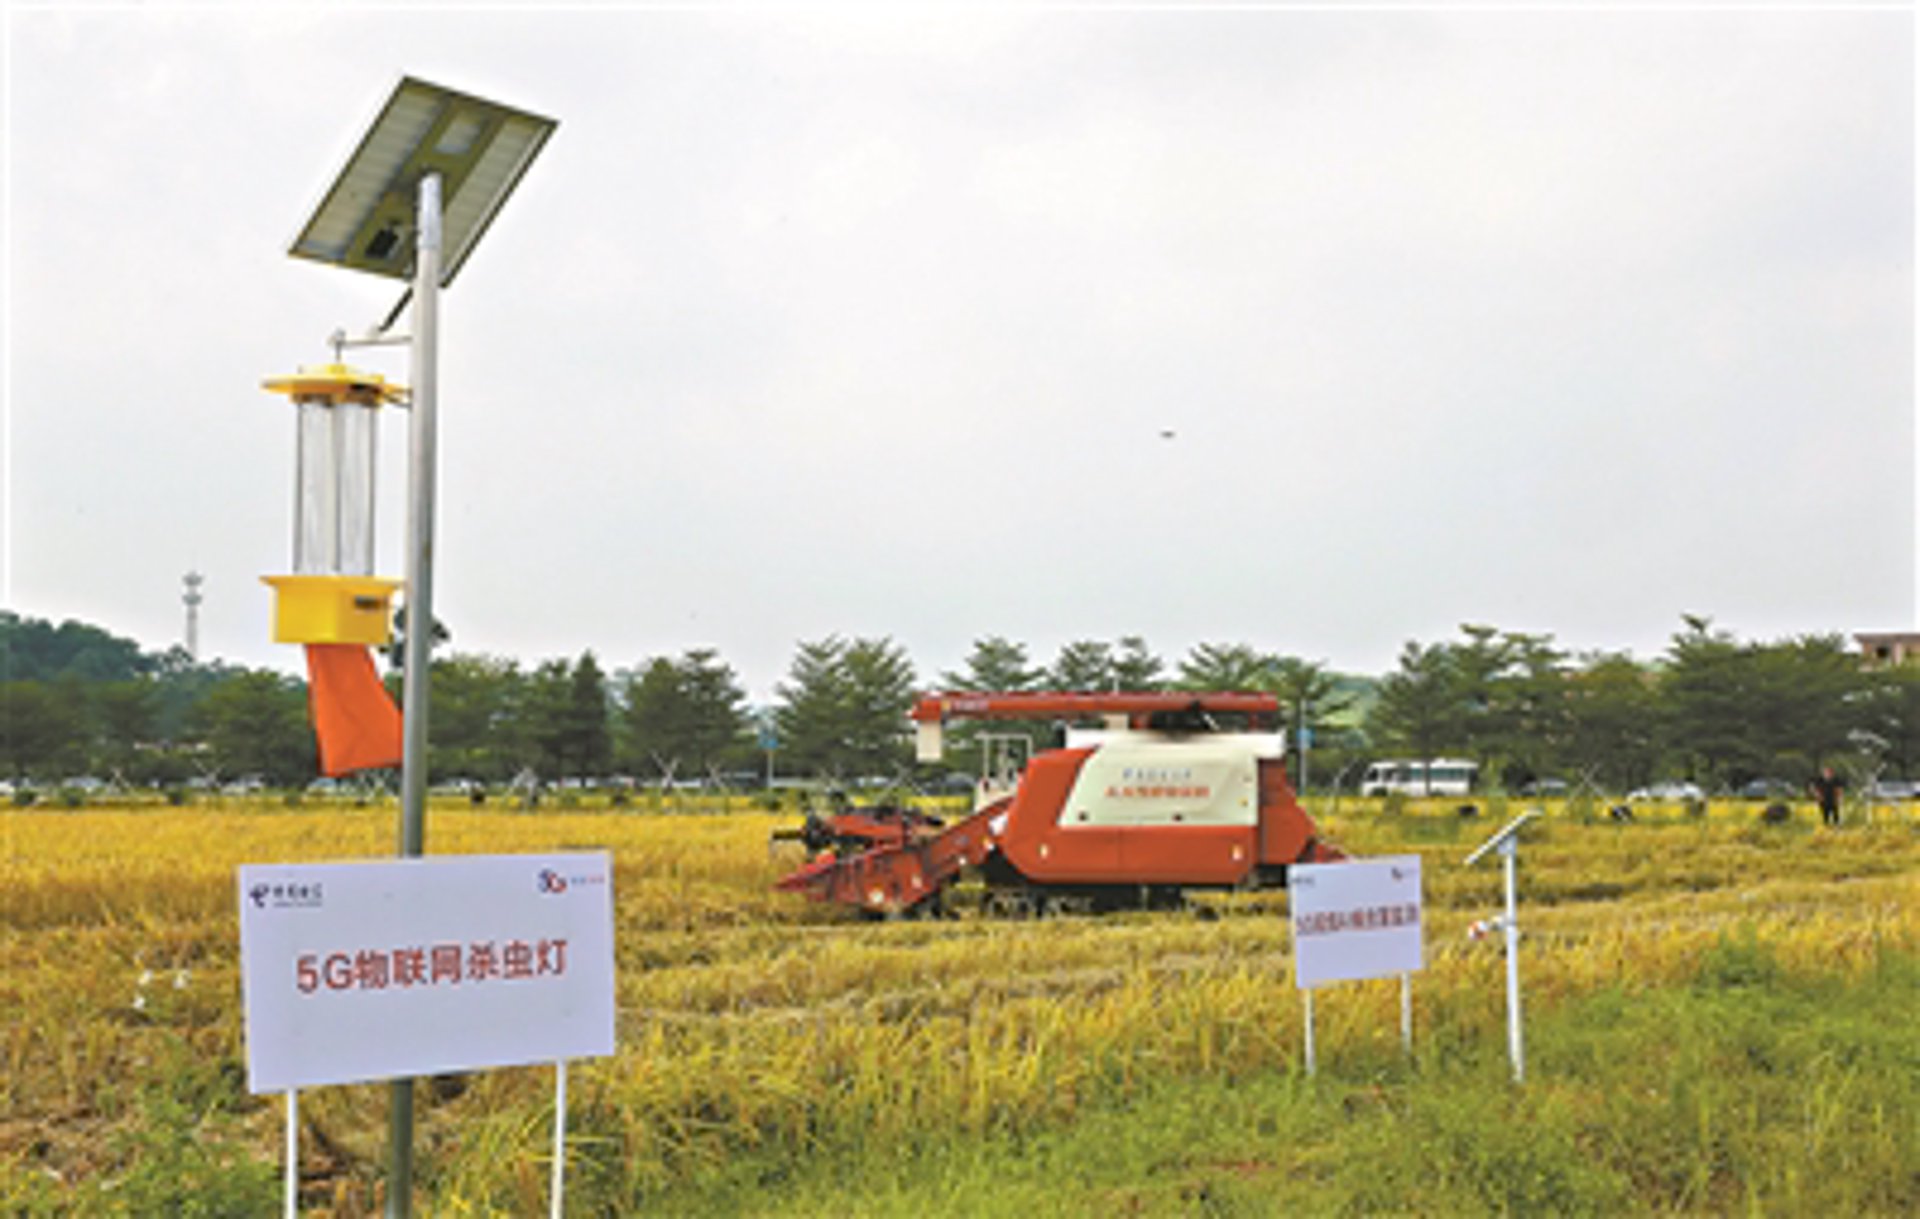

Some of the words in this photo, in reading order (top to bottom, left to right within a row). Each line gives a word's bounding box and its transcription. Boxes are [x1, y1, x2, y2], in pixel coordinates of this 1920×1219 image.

[296, 939, 568, 993] 5G物联网杀虫灯
